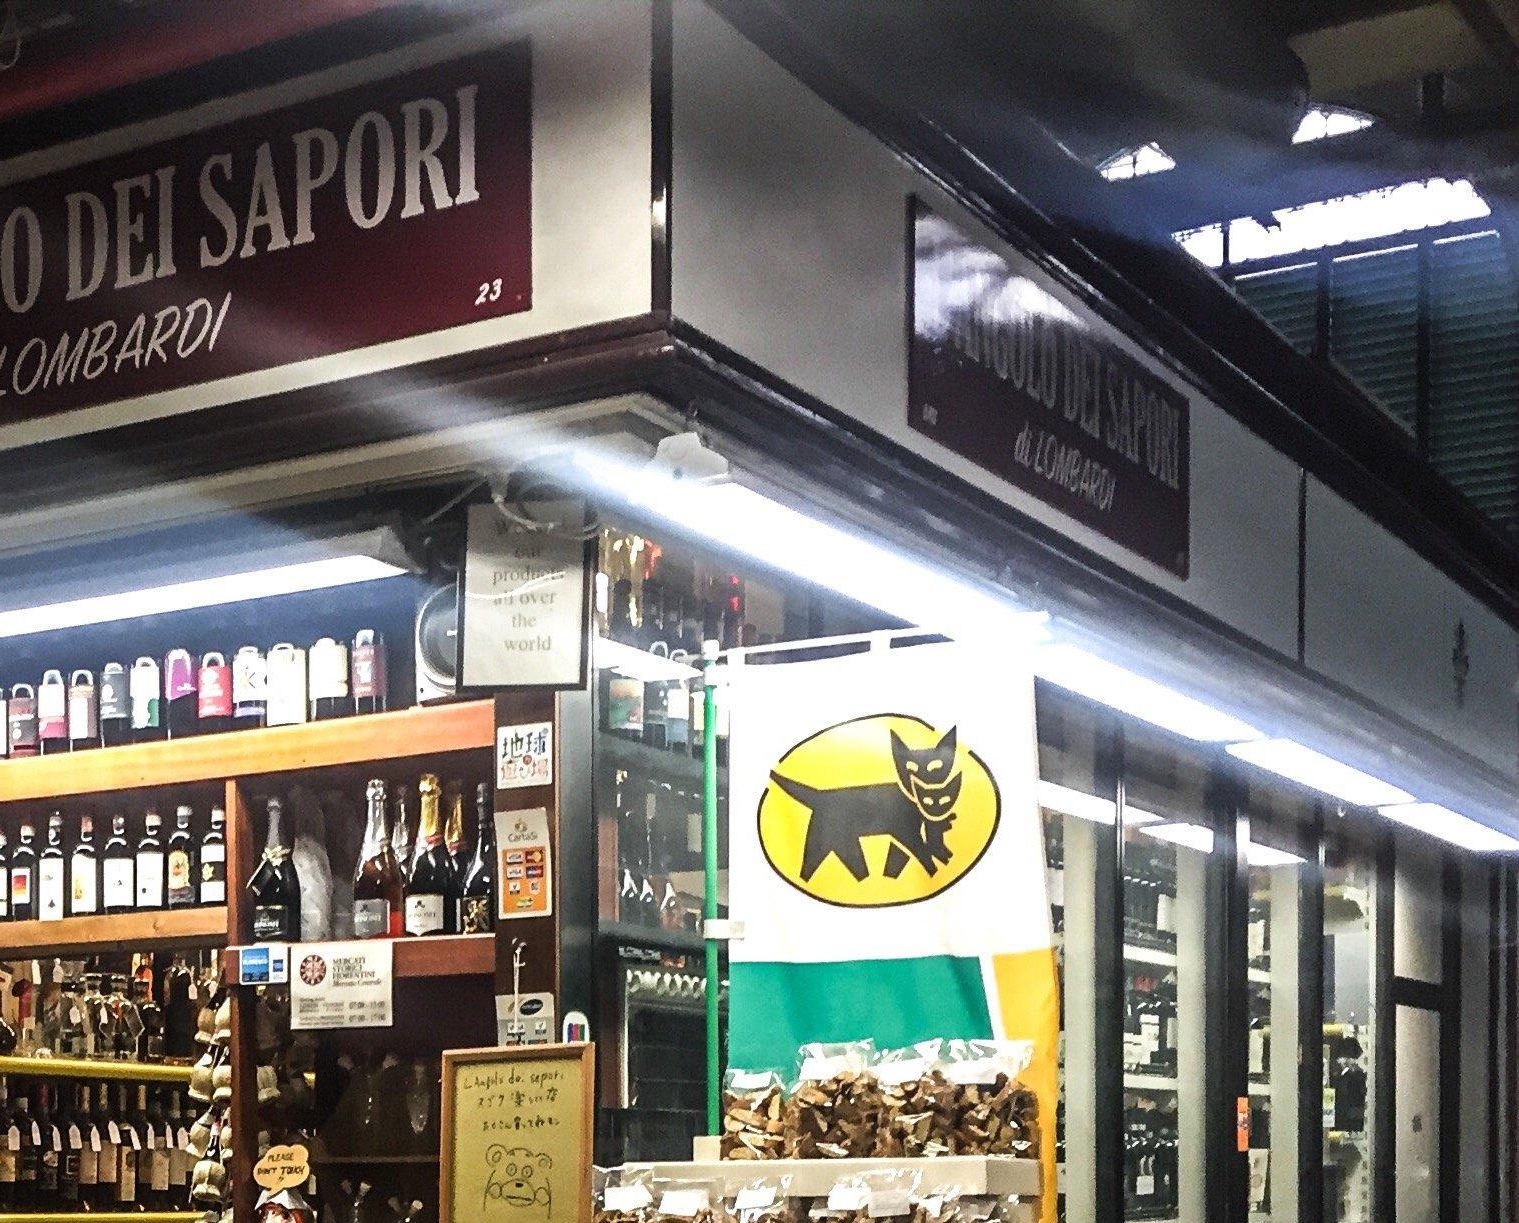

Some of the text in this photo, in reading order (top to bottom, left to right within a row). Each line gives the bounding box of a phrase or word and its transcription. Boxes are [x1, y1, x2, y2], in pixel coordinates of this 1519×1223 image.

[64, 165, 178, 303] DEI
[198, 84, 482, 270] SAPORI
[473, 278, 503, 306] 23
[519, 590, 557, 605] over
[512, 613, 537, 629] the
[504, 635, 552, 652] world
[267, 1153, 294, 1162] PLEASE
[257, 1166, 305, 1175] DON'T TOUCH
